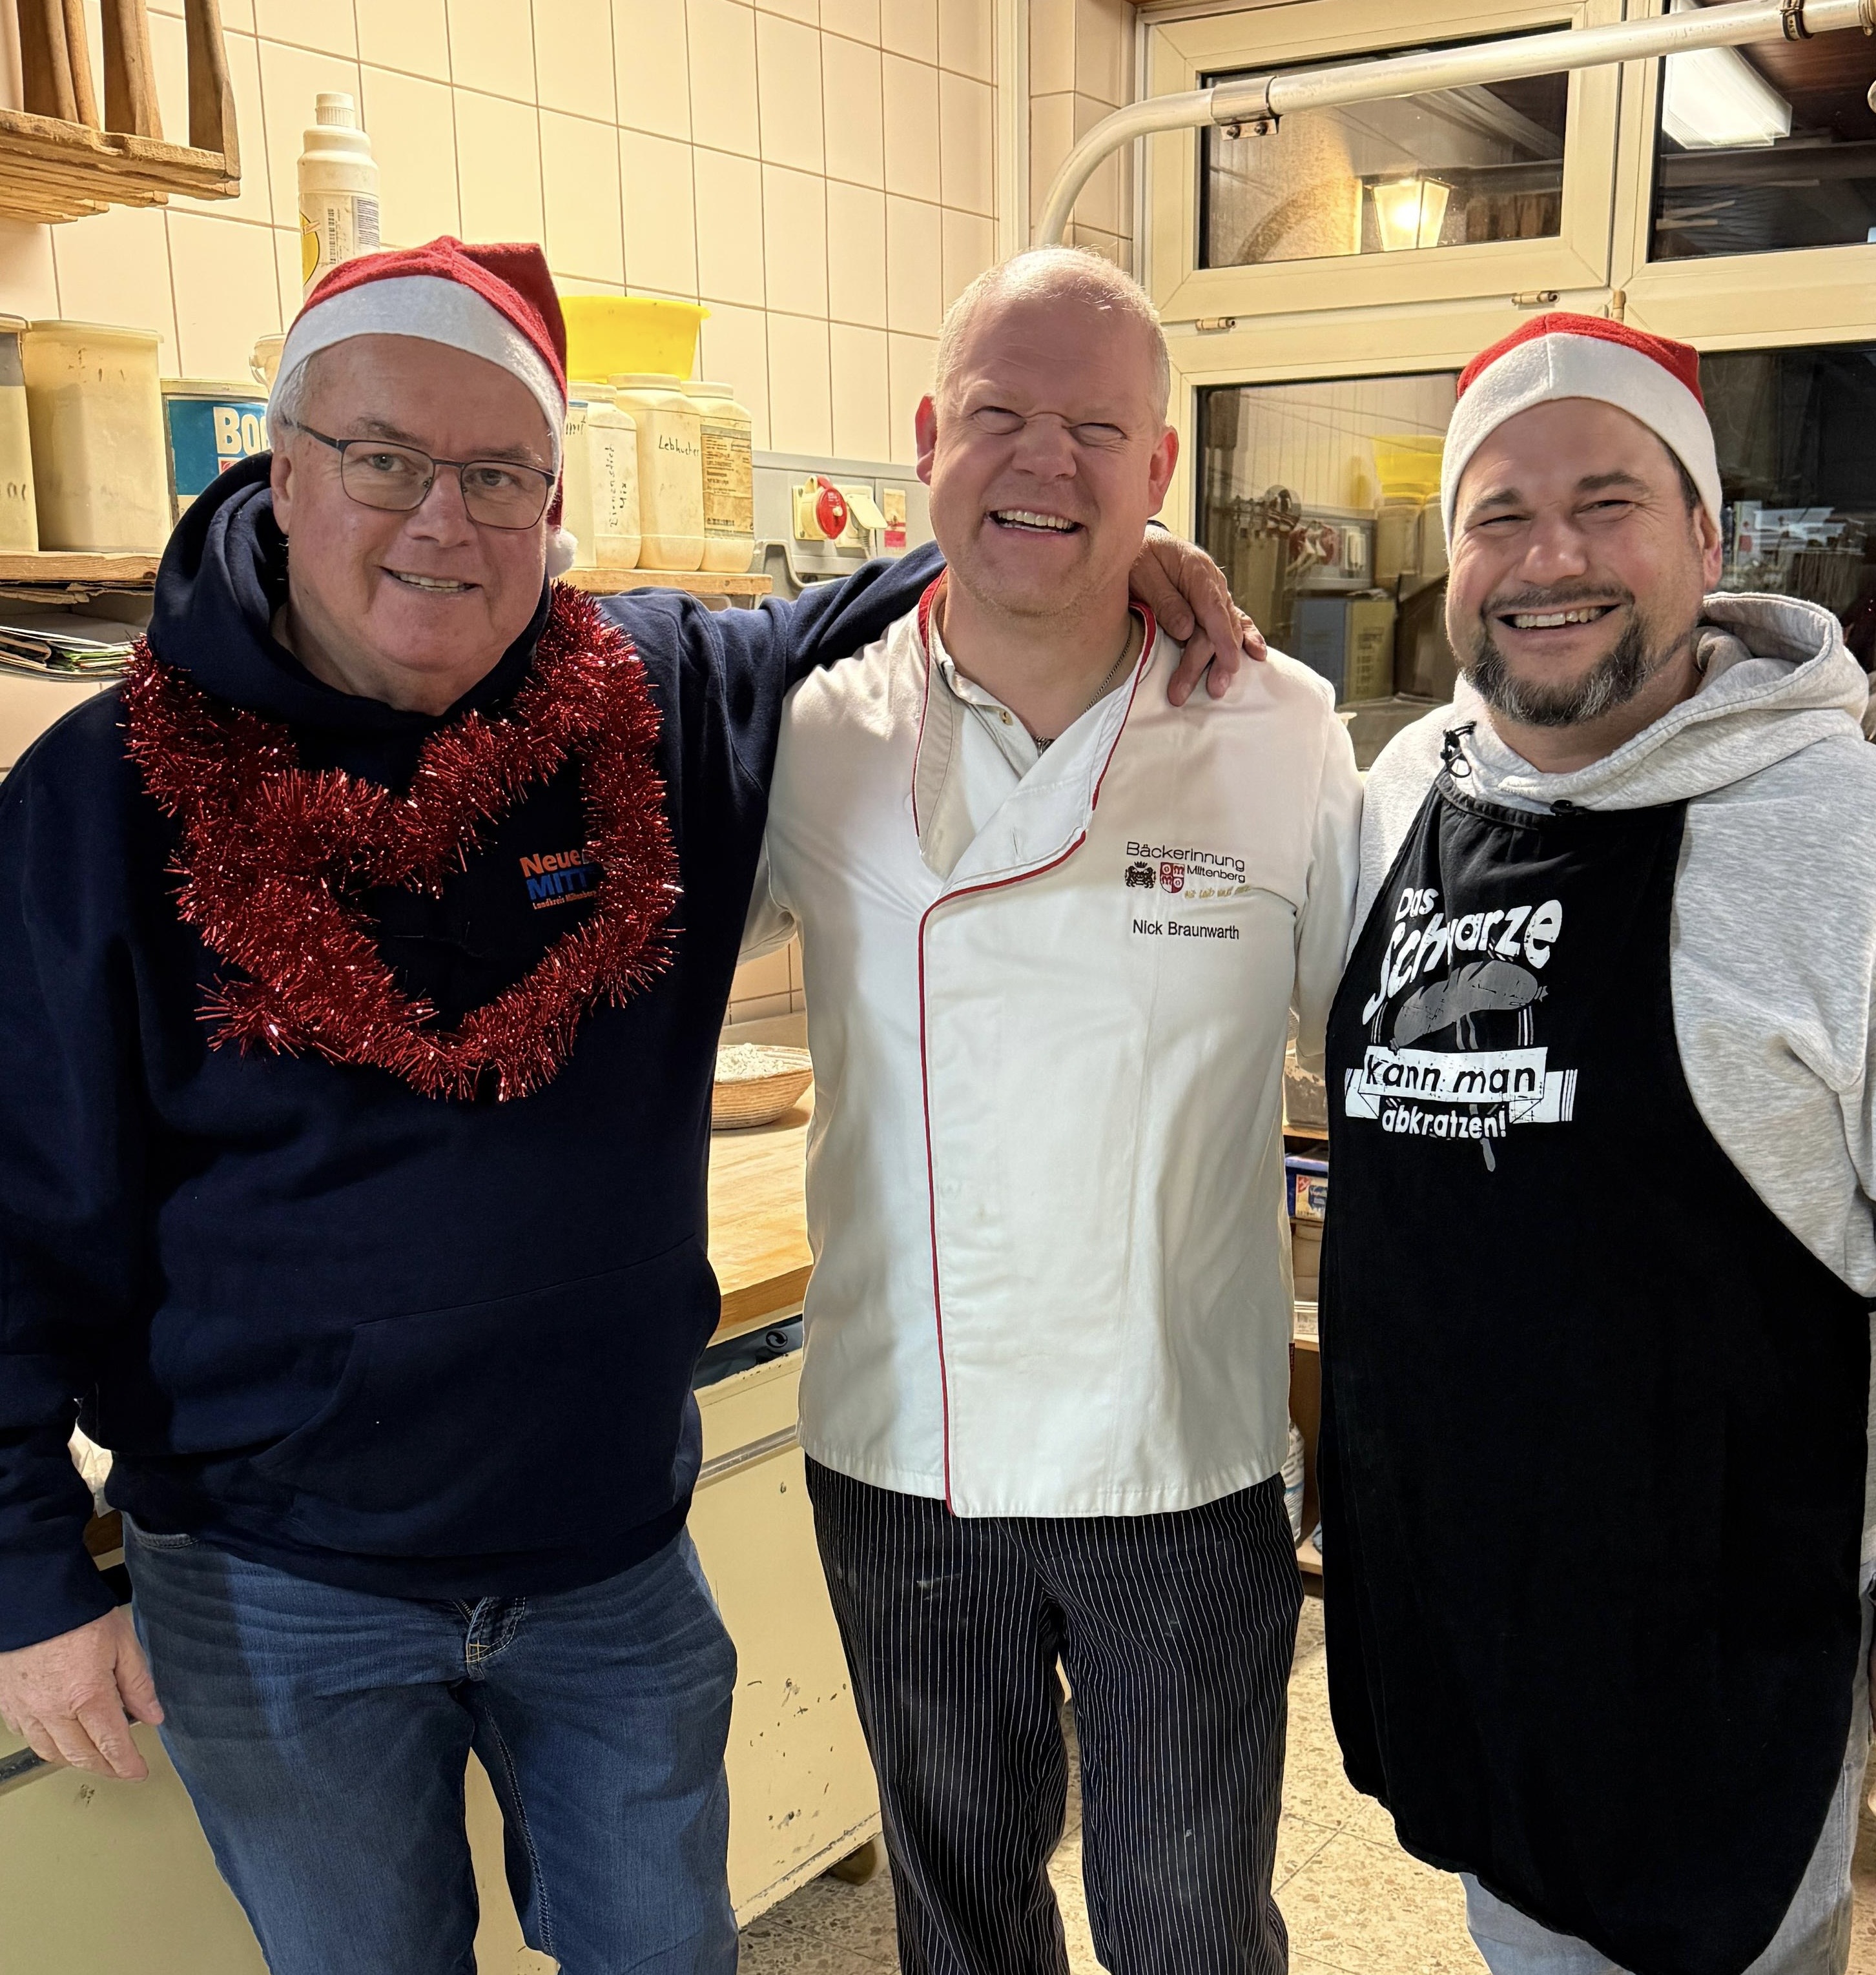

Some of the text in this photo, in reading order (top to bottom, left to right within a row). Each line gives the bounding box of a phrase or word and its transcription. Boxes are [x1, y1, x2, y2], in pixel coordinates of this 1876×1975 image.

[519, 849, 581, 877] Neue
[1126, 841, 1245, 872] Bäckerinnung
[526, 866, 593, 900] MITT
[1187, 865, 1246, 883] Miltenberg
[1395, 888, 1439, 923] Das
[1133, 919, 1239, 940] Nick Braunwarth
[1365, 1054, 1536, 1096] kann man
[1382, 1104, 1507, 1138] abkratzen!
